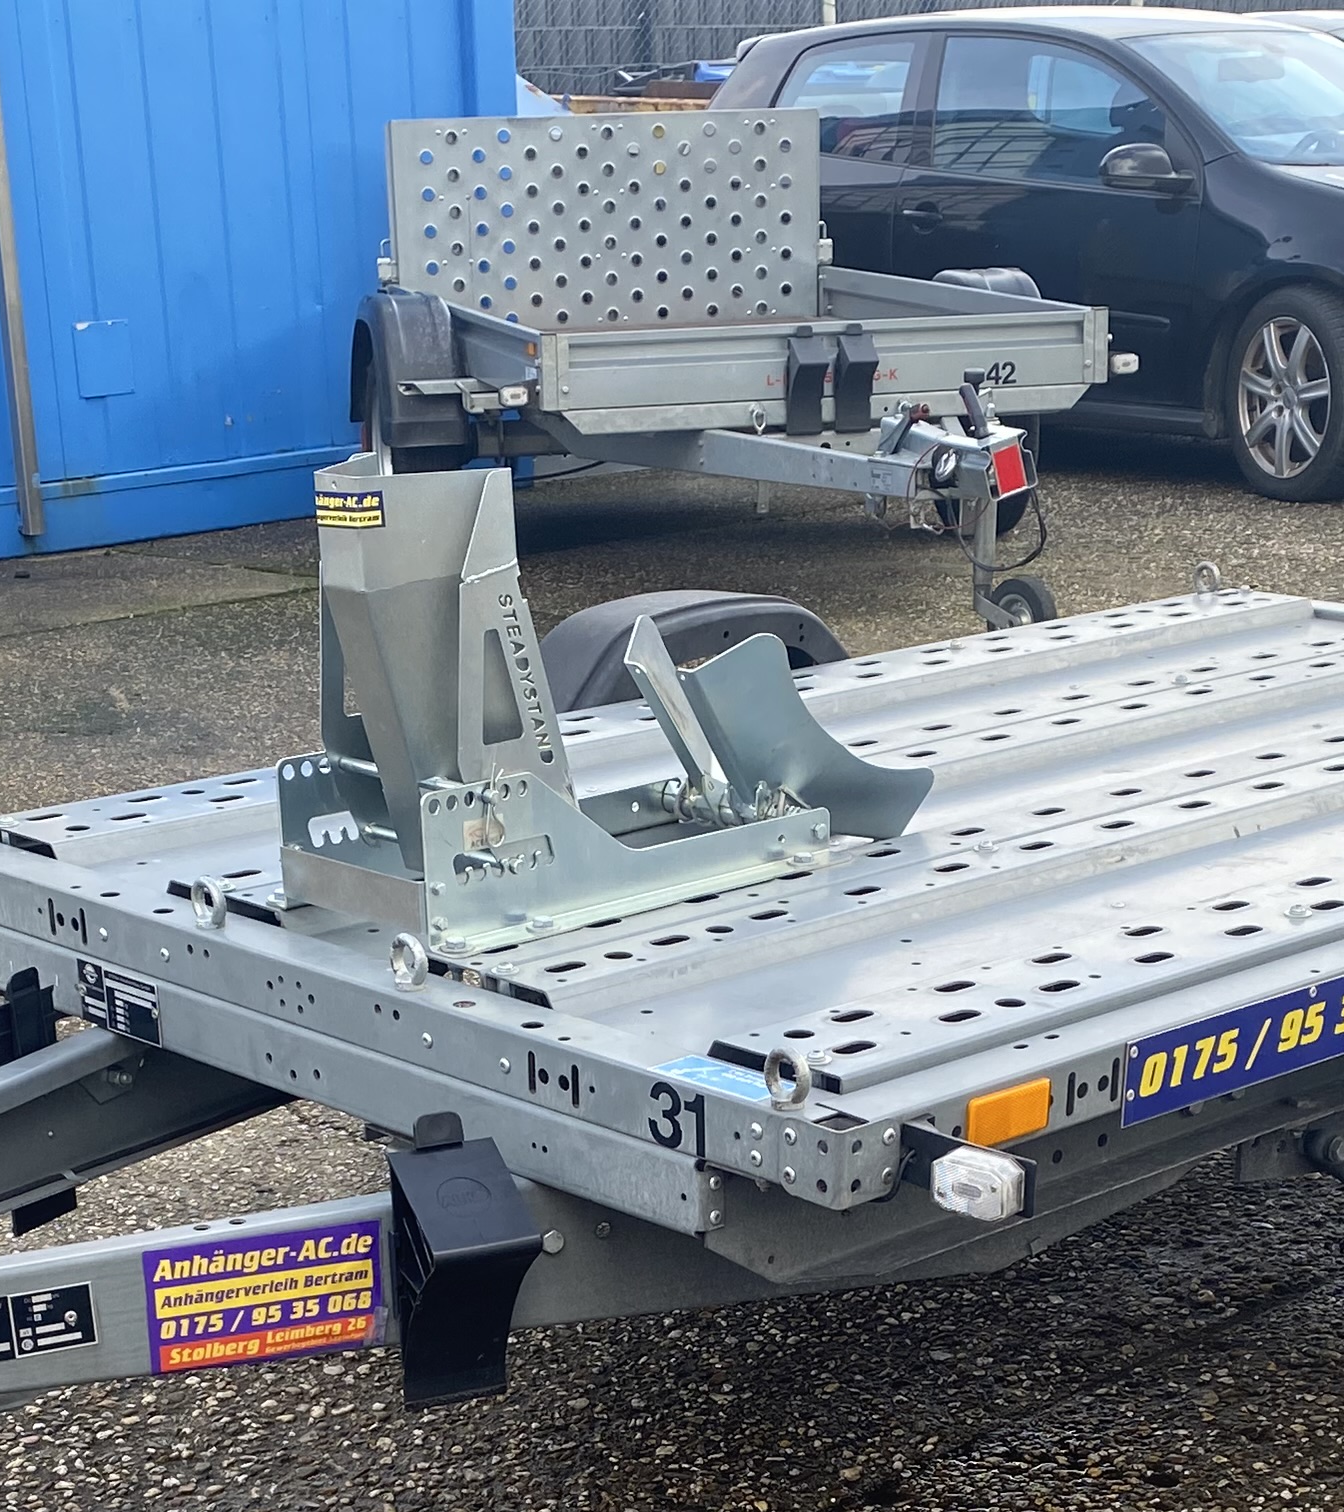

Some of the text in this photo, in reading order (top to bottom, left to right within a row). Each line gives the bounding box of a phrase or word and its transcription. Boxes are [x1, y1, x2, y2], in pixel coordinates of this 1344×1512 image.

[986, 361, 1017, 385] 42
[498, 593, 554, 765] STEADYSTAND
[1139, 1028, 1240, 1098] 0175
[1244, 1017, 1272, 1071] /
[1277, 1001, 1326, 1053] 95
[648, 1081, 705, 1158] 31
[153, 1233, 374, 1283] Anhänger-AC.de
[160, 1268, 369, 1310] Anhängerverleih Bertram
[160, 1290, 372, 1340] 0175 / 95 35 068
[169, 1338, 260, 1365] Stolberg
[266, 1321, 342, 1345] Leimberg
[347, 1317, 367, 1331] 26
